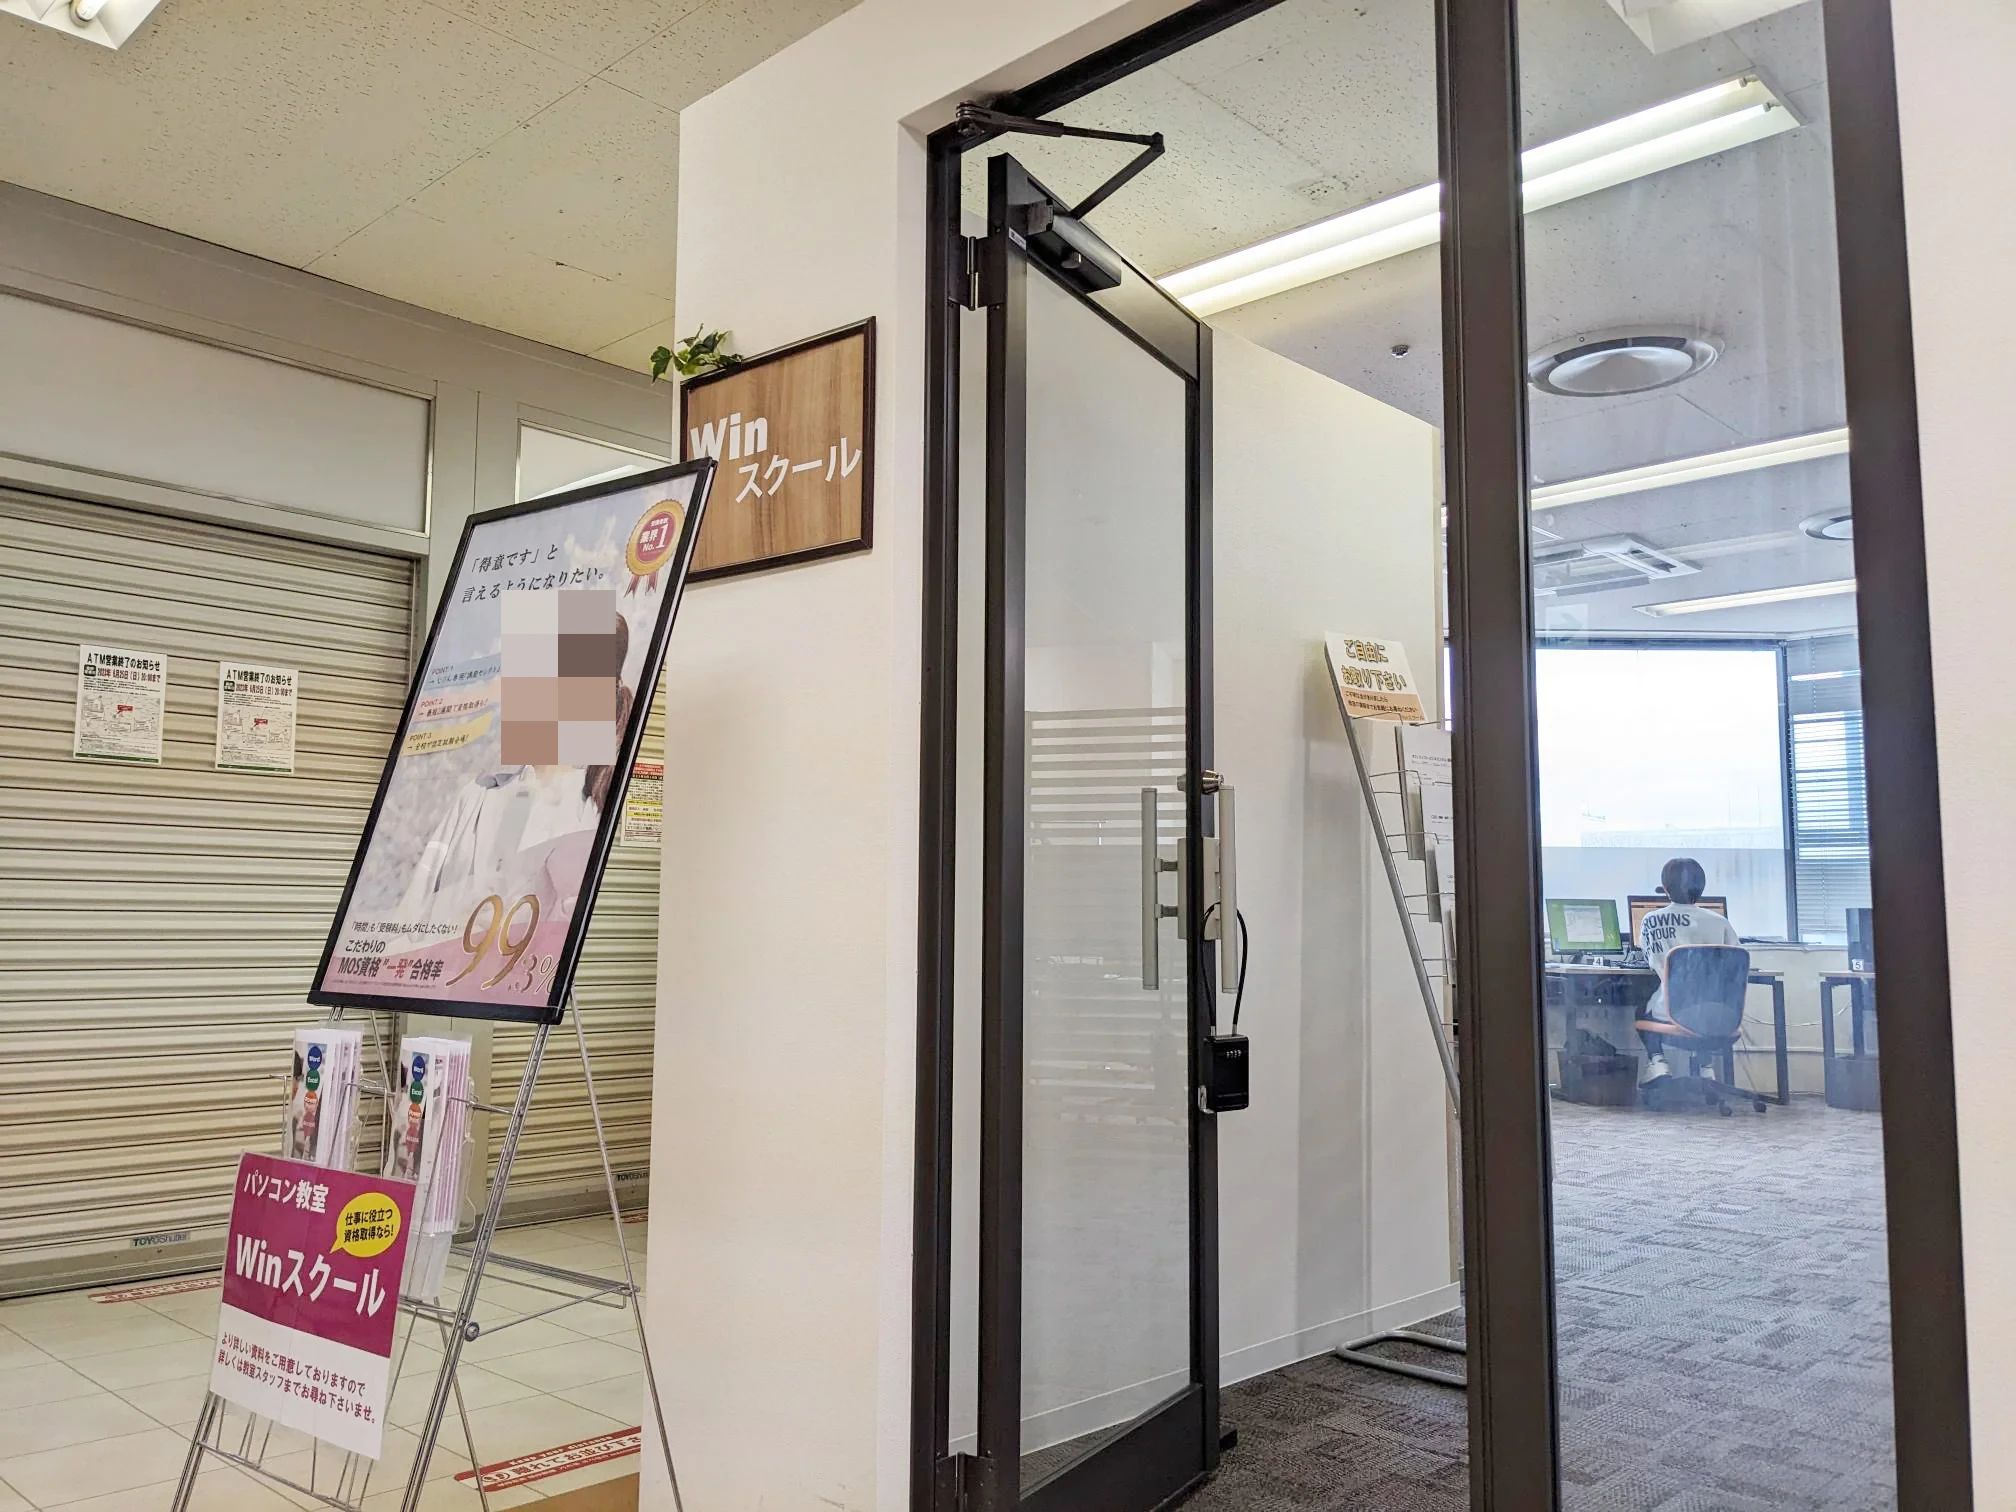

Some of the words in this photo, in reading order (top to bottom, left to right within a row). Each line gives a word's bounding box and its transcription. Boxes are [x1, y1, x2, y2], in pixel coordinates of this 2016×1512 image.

[690, 412, 768, 460] Win
[735, 437, 862, 503] スクール
[640, 529, 659, 544] 業界
[462, 567, 605, 603] 言えるようになりたい。
[1343, 639, 1388, 663] ご自由に
[1341, 665, 1407, 690] お取り下さい
[345, 939, 386, 954] こだわりの
[1650, 927, 1676, 941] YOUR
[307, 1076, 318, 1084] Excel
[243, 1169, 329, 1214] パソコン教室
[345, 1207, 393, 1226] 仕事に役立つ
[235, 1233, 386, 1318] Winスクール
[221, 1331, 367, 1397] より詳しい資料をご用意しておりますので
[218, 1349, 375, 1424] 詳しくは教室スタッフまでお尋ね下さいませ。
